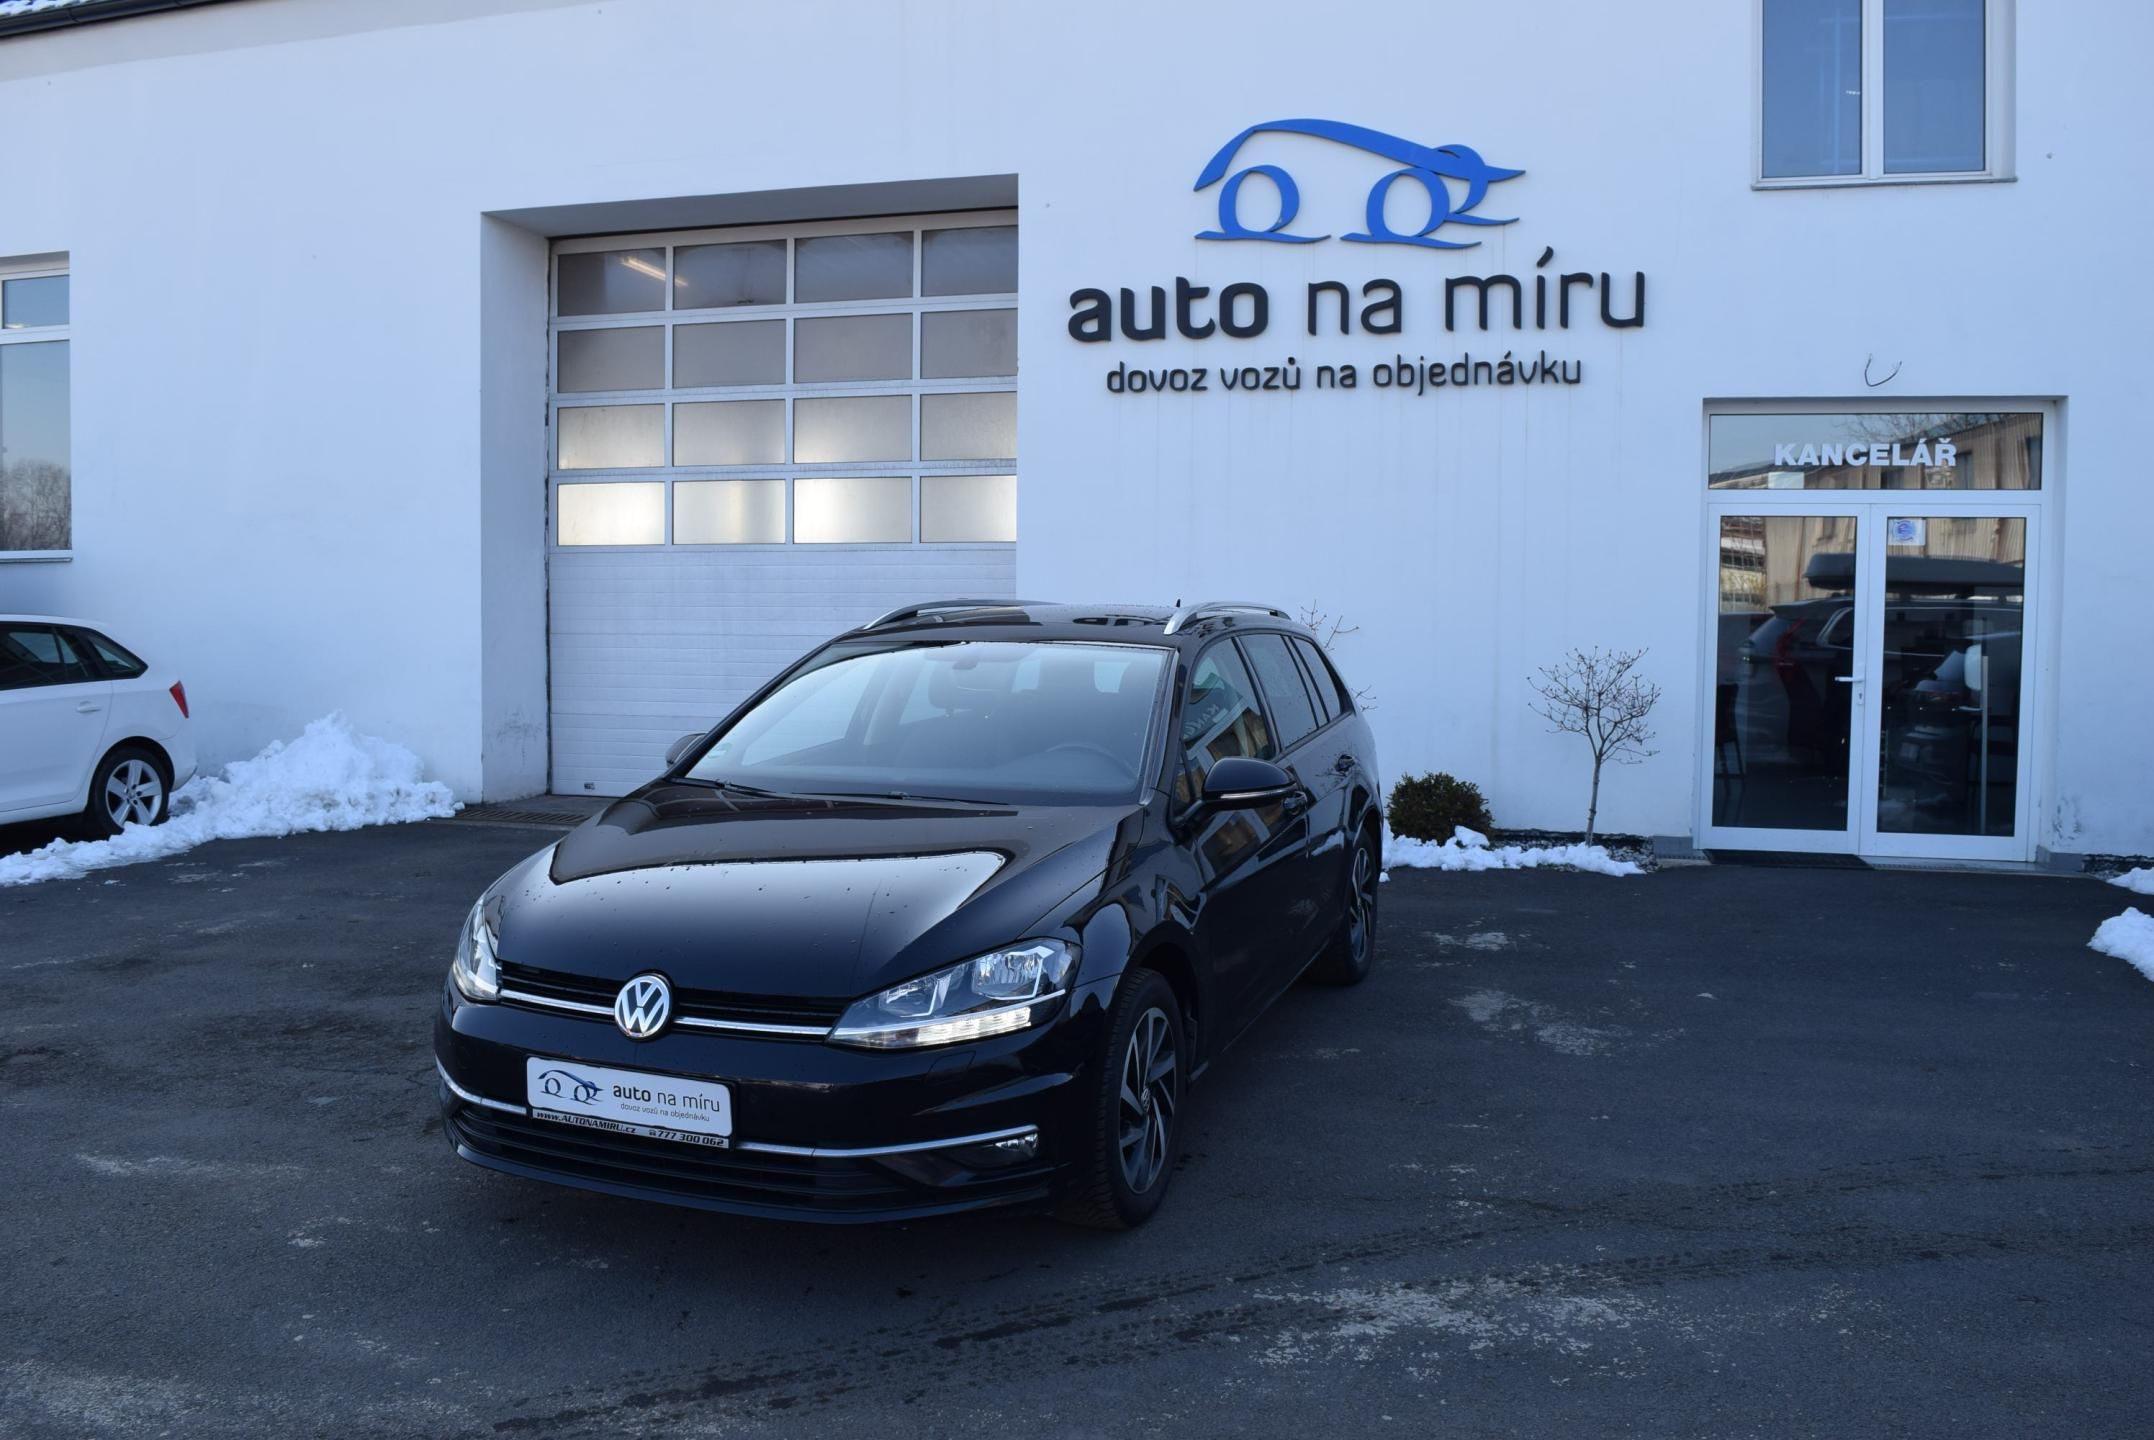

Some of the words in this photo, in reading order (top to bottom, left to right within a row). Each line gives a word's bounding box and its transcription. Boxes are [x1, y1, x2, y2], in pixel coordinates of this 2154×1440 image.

[1067, 276, 1270, 343] auto
[1307, 278, 1402, 336] na
[1444, 246, 1646, 332] míru
[1106, 361, 1208, 394] dovoz
[1219, 356, 1302, 392] vozů
[1316, 363, 1358, 390] na
[1372, 350, 1583, 397] objednávku
[1773, 437, 1958, 468] KANCELÁŘ
[613, 1085, 652, 1103] auto
[657, 1091, 677, 1107] na
[682, 1093, 720, 1113] míru
[659, 1109, 669, 1117] na
[658, 1130, 678, 1140] 777
[680, 1133, 701, 1144] 300
[702, 1136, 725, 1147] 062
